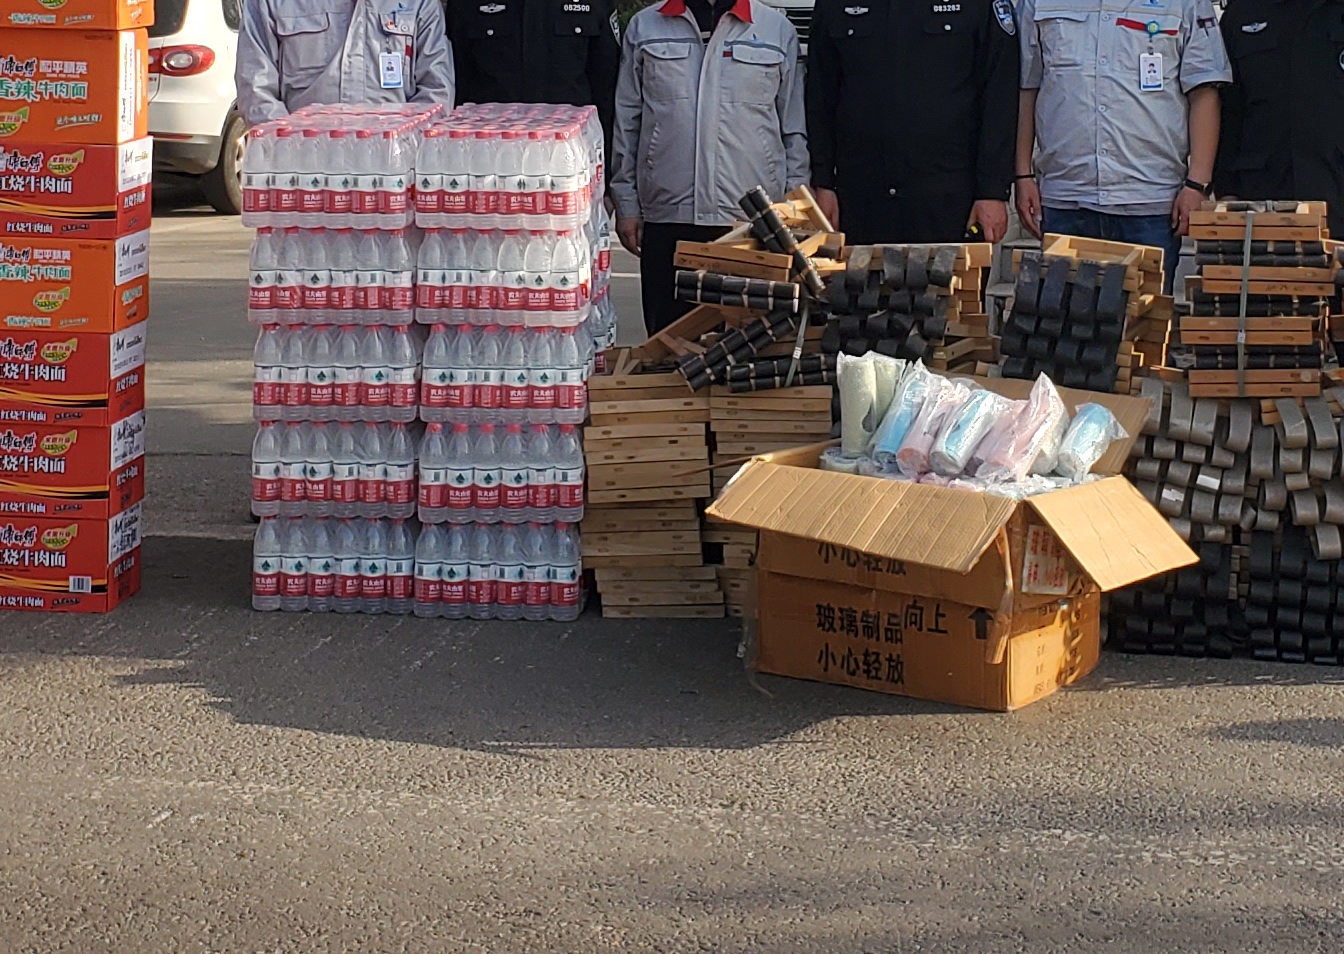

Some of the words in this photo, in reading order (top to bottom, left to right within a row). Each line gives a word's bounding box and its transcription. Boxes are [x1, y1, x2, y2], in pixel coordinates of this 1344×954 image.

[816, 603, 904, 645] 玻璃制品
[906, 599, 948, 635] 向上
[818, 642, 905, 685] 小心轻放
